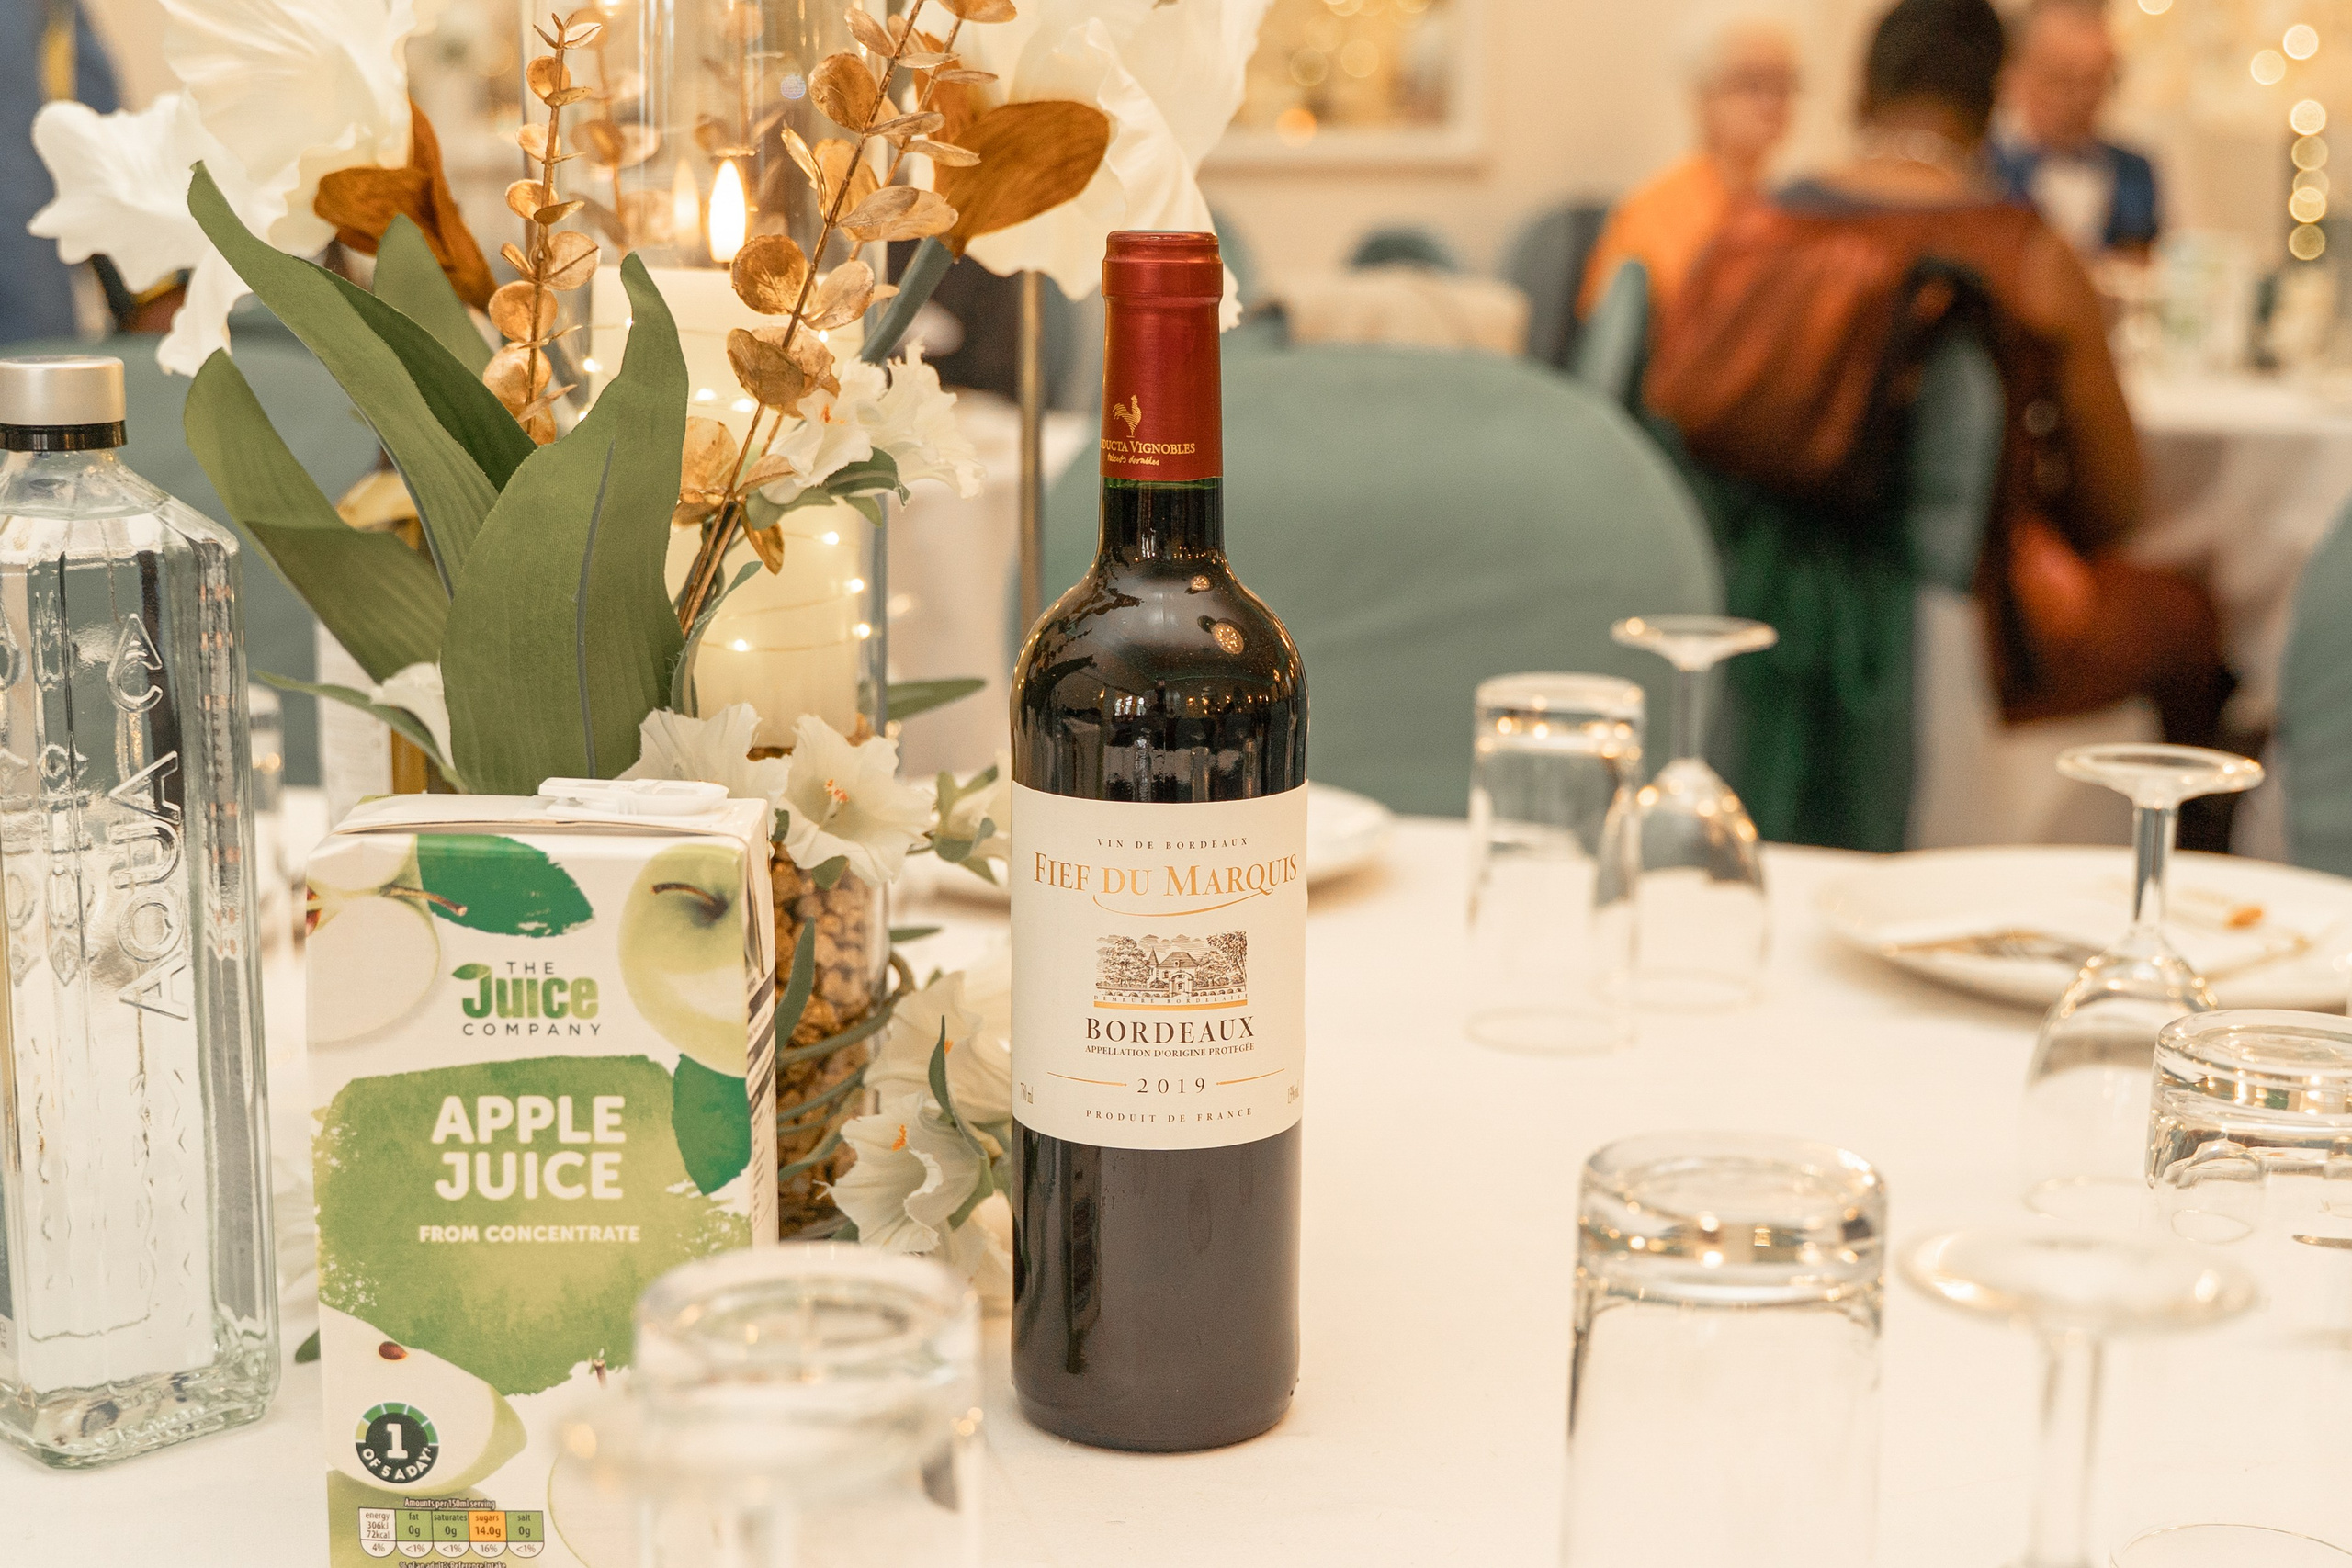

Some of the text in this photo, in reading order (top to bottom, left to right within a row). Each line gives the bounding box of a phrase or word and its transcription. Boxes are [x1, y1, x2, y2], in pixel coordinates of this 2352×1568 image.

[1100, 438, 1195, 455] DUCTA VIGNOBLES
[1097, 837, 1249, 851] VIN DE BORDEAUX
[1034, 851, 1298, 897] FIEF DU MARQUIS
[108, 750, 189, 1021] AQUA
[506, 962, 556, 976] THE
[451, 963, 600, 1020] Juice
[462, 1022, 602, 1037] COMPANY
[1085, 1015, 1255, 1044] BORDEAUX
[1084, 1043, 1255, 1058] APPELLATION D'ORIGINE PROTEGÉE
[1136, 1077, 1206, 1094] 2019
[431, 1095, 627, 1145] APPLE
[1085, 1107, 1253, 1123] PRODUIT DE FRANCE
[435, 1151, 624, 1201] JUICE
[419, 1225, 641, 1244] FROM CONCENTRATE
[386, 1422, 408, 1459] 1
[362, 1448, 381, 1467] OF
[381, 1465, 391, 1477] 5
[394, 1468, 406, 1480] A
[404, 1497, 496, 1511] Amounts per 150ml serving
[366, 1512, 390, 1522] energy
[408, 1512, 419, 1521] fat
[434, 1513, 468, 1521] saturates
[475, 1514, 499, 1523] sugars
[367, 1530, 390, 1539] 72kcal
[408, 1525, 421, 1537] 0g
[445, 1526, 458, 1538] 0g
[475, 1526, 501, 1538] 14.0g
[518, 1526, 531, 1538] 0g
[372, 1543, 385, 1552] 4%
[405, 1544, 425, 1552] <1%
[442, 1544, 462, 1552] <1%
[481, 1544, 498, 1553] 16%
[516, 1544, 537, 1553] <1%
